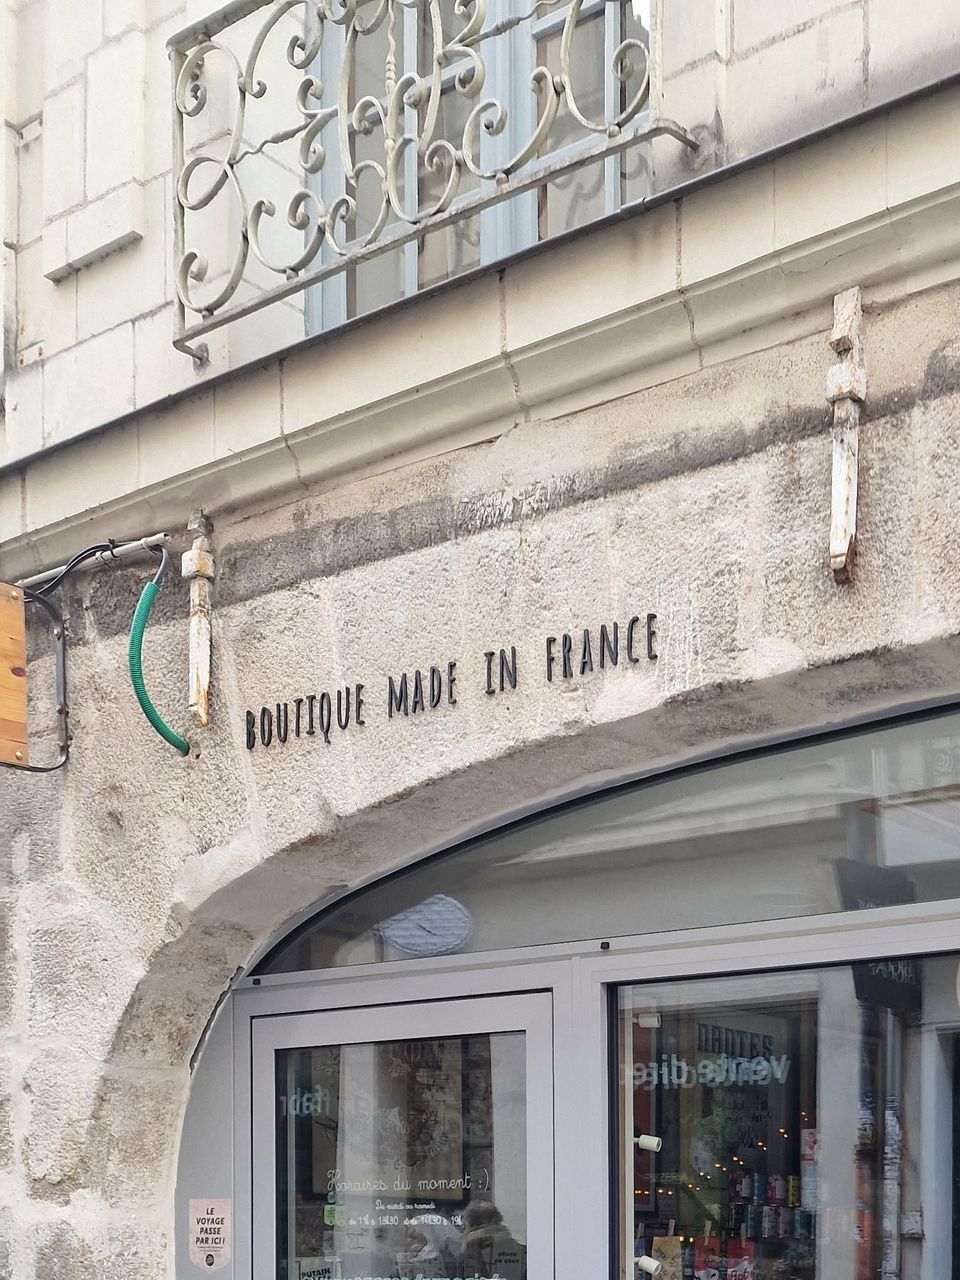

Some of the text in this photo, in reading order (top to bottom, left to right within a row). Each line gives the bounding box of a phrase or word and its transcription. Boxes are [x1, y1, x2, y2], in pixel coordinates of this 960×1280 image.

[245, 613, 659, 750] BOUTIQUE MADE IN FRANCE
[326, 1168, 388, 1192] Horaires
[392, 1174, 411, 1191] du
[417, 1171, 472, 1191] moment
[206, 1207, 215, 1216] LE
[196, 1217, 225, 1226] VOYAGE
[199, 1227, 222, 1235] PASSE
[195, 1237, 210, 1245] PAR
